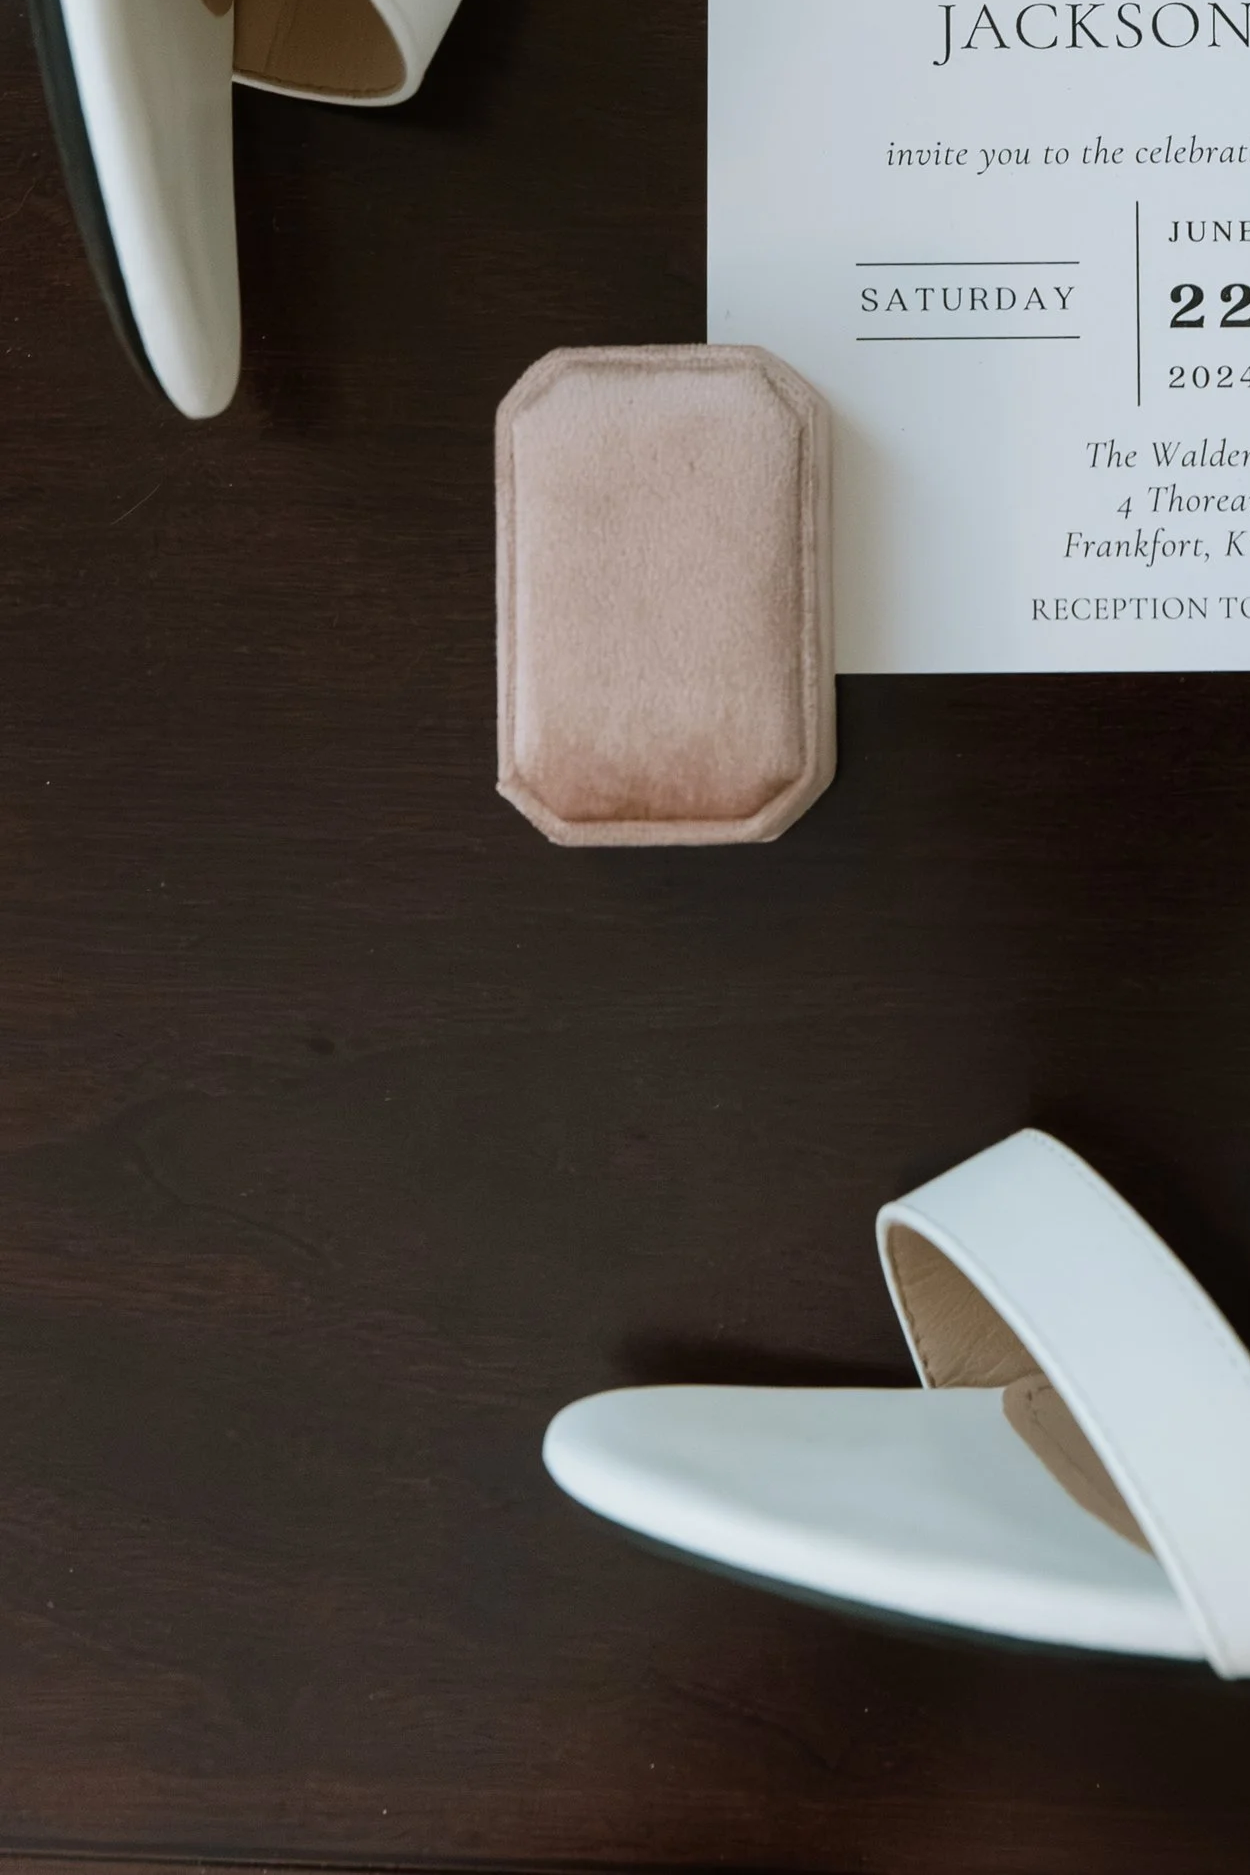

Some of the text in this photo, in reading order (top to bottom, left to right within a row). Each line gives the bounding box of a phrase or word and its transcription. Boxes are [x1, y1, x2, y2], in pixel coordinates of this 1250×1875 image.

[886, 141, 968, 166] invite
[976, 148, 1031, 176] you
[1043, 145, 1070, 165] to
[1082, 135, 1124, 165] the
[861, 286, 1076, 313] SATURDAY
[1086, 438, 1138, 469] The
[1116, 496, 1132, 520] 4
[1064, 527, 1210, 568] Frankfort,
[1032, 597, 1208, 621] RECEPTION
